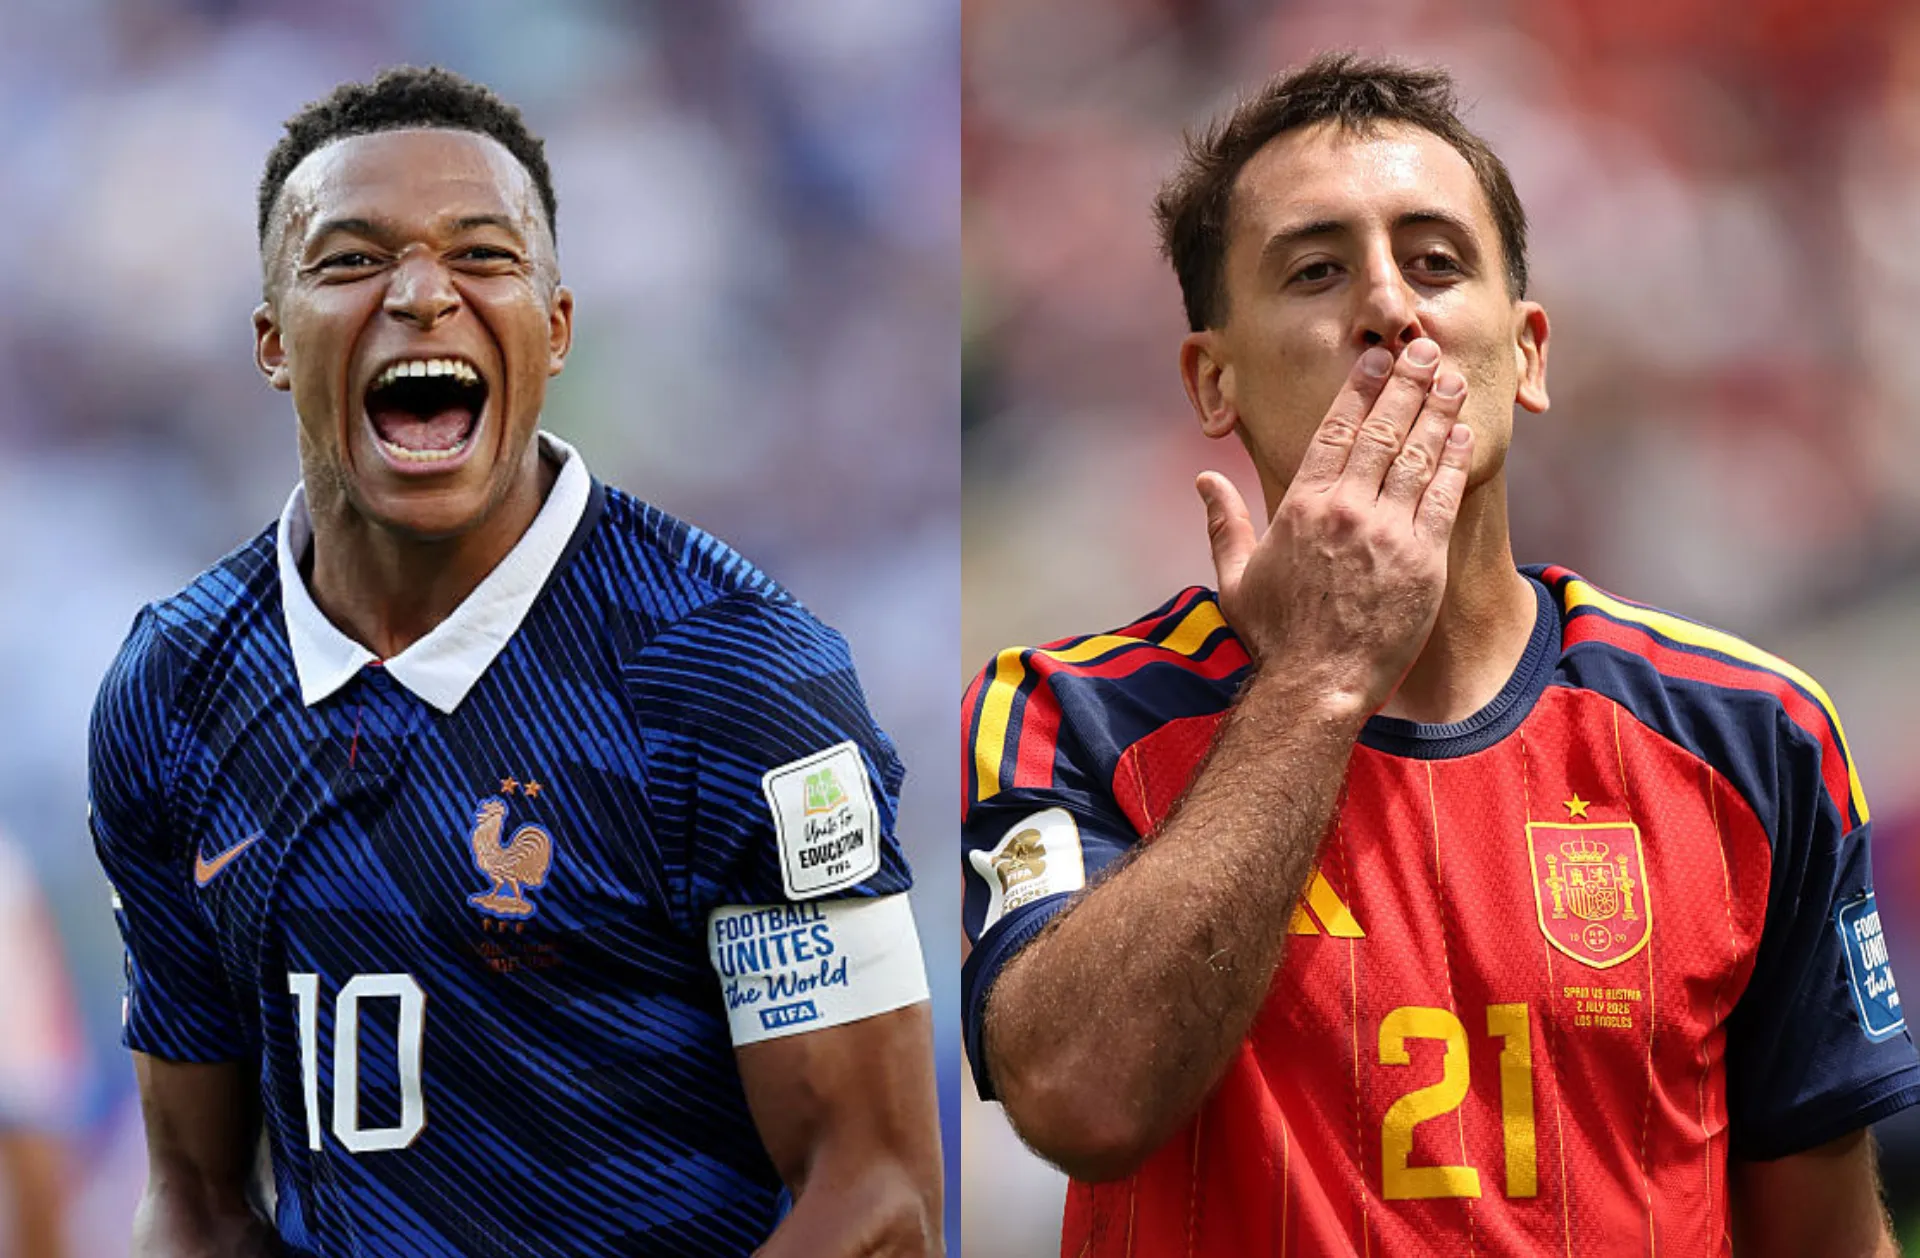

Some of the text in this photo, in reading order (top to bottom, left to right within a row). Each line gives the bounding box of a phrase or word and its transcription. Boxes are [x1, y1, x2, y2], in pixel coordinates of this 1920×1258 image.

[799, 828, 864, 868] EDUCATION
[715, 902, 826, 942] FOOTBALL
[718, 924, 834, 977] UNITES
[725, 956, 848, 1010] the World
[1563, 986, 1589, 999] SPAIN
[1605, 988, 1642, 1001] AUSTRIA
[765, 1006, 814, 1027] FIFA
[1574, 1015, 1592, 1026] LOS
[1576, 1001, 1583, 1012] 2
[1586, 1001, 1605, 1013] JULY
[288, 973, 425, 1153] 10
[1379, 1003, 1538, 1200] 21
